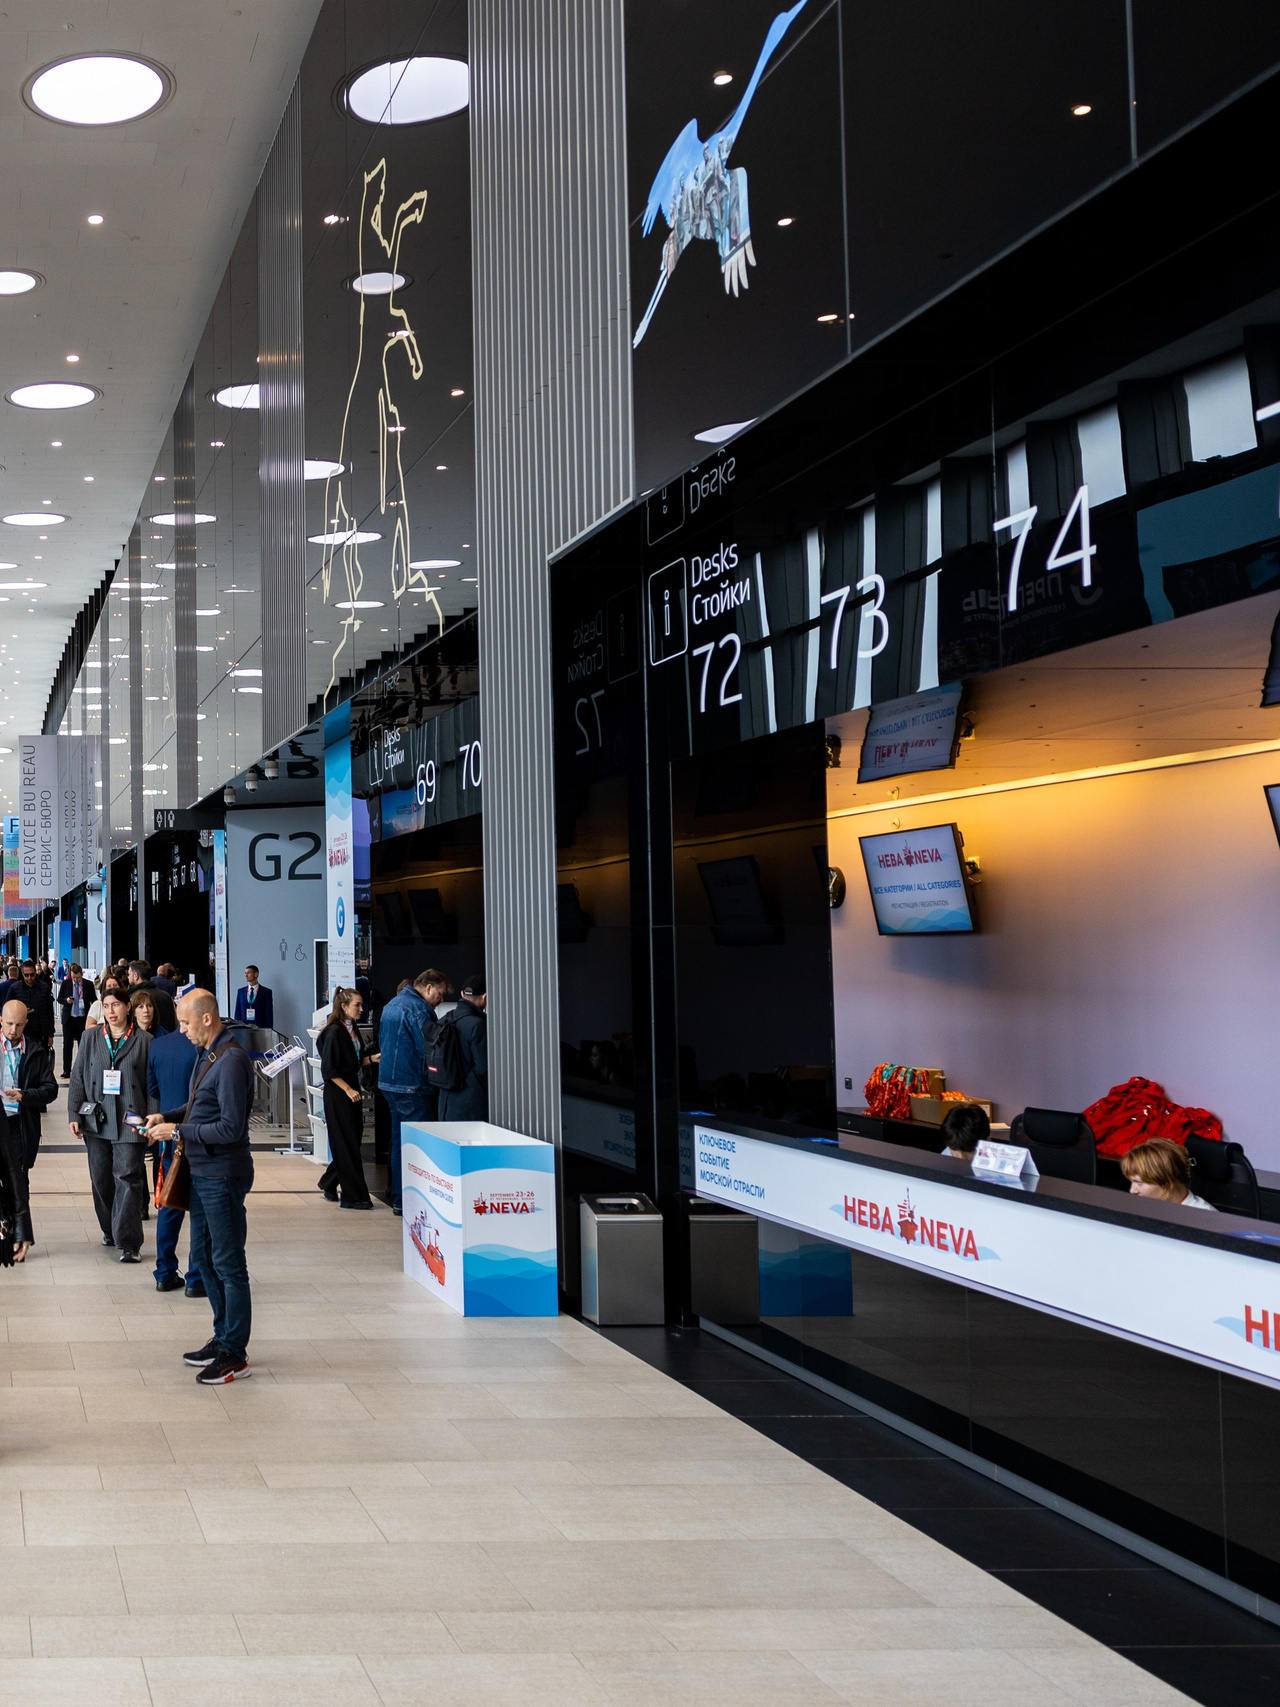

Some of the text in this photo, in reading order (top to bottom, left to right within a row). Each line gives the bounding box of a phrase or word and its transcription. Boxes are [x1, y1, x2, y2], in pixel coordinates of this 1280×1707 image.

[691, 542, 738, 588] Desks
[992, 484, 1097, 612] 74
[692, 577, 751, 625] Стойки
[820, 573, 889, 670] 73
[692, 632, 743, 713] 72
[384, 726, 401, 748] Desks
[416, 760, 436, 806] 69
[459, 740, 483, 791] 70
[23, 819, 36, 886] SERVICE
[40, 790, 52, 887] СЕРВИС-БЮРО
[248, 831, 323, 882] G2
[877, 848, 943, 869] НЕВА NEVA
[873, 886, 884, 895] ВСЕ
[884, 884, 913, 893] КАТЕГОРИИ
[916, 882, 927, 891] ALL
[927, 880, 962, 890] CATEGORIES
[699, 1133, 736, 1153] КЛЮЧЕВОЕ
[699, 1151, 730, 1170] СОБЫТИЕ
[700, 1169, 765, 1199] МОРСКОЙ ОТРАСЛИ
[490, 1202, 530, 1214] NEVA
[844, 1195, 980, 1261] НЕВА NEVA
